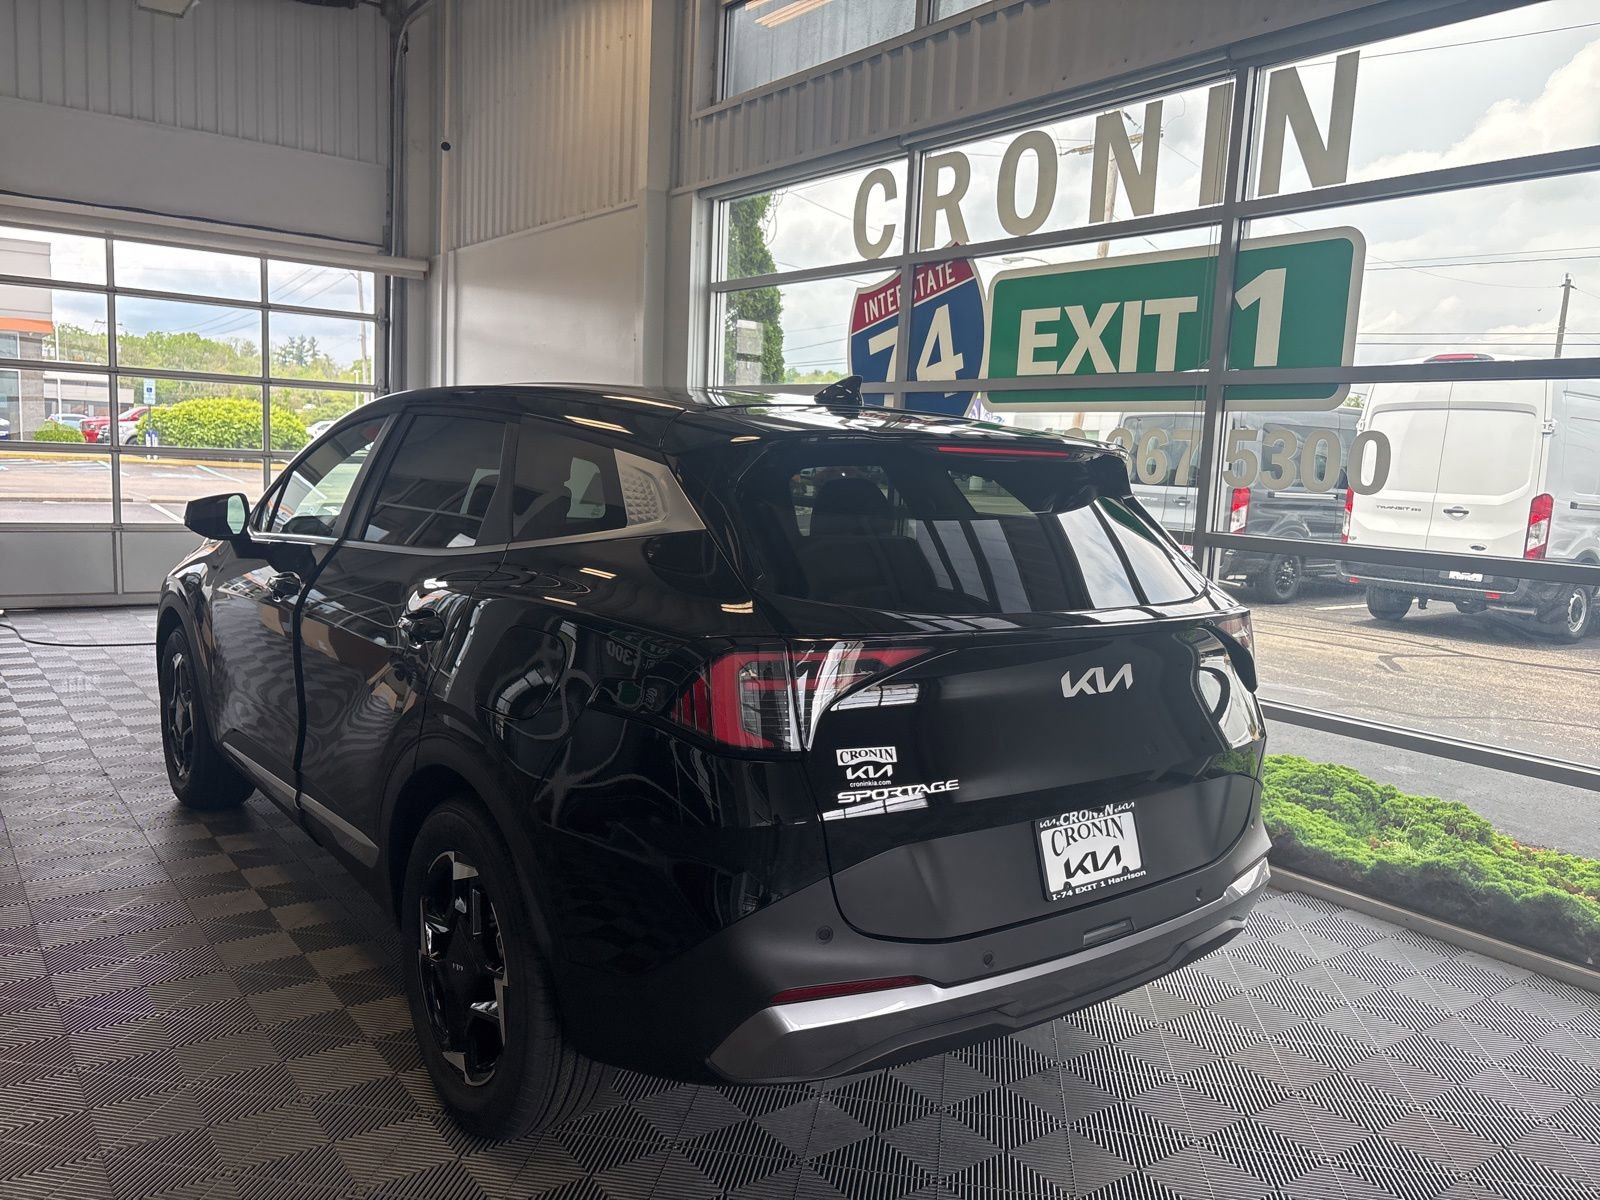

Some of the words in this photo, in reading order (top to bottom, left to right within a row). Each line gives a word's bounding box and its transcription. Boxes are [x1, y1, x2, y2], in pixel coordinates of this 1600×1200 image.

[852, 50, 1361, 260] CRONIN
[863, 261, 956, 324] INTETATE
[1016, 296, 1198, 376] EXIT
[1234, 267, 1287, 367] 1
[868, 303, 964, 408] 74
[1222, 428, 1391, 496] 5300
[1060, 663, 1133, 698] KIA
[840, 748, 894, 764] CRONIN
[846, 764, 893, 780] KIA
[837, 779, 960, 804] SPORTAGE
[849, 780, 892, 788] croninkia.com
[1051, 816, 1125, 857] CRONIN
[1063, 845, 1122, 880] KIA
[1051, 889, 1073, 901] I-74
[1075, 882, 1098, 894] EXIT
[1108, 870, 1147, 885] Harrison
